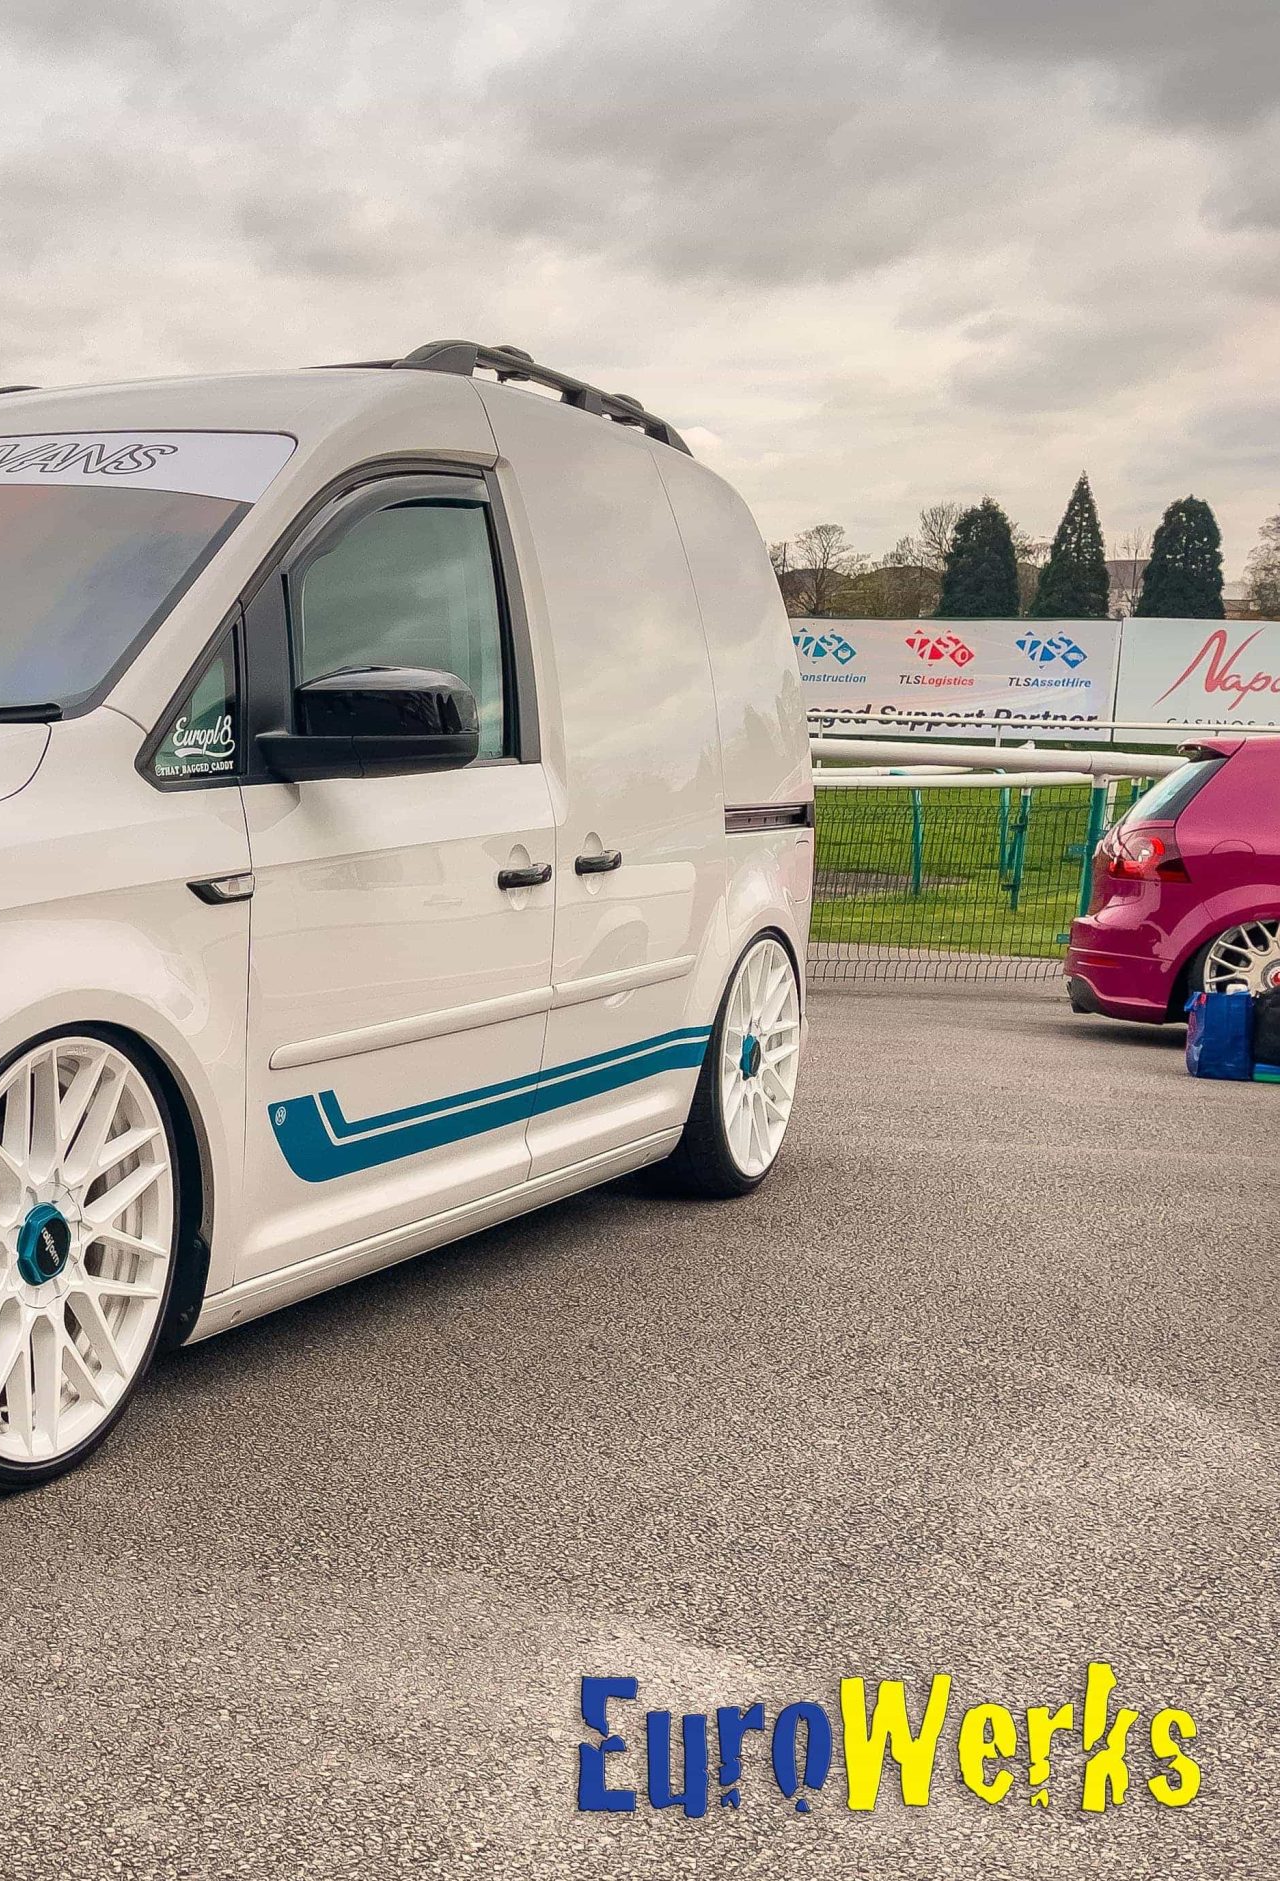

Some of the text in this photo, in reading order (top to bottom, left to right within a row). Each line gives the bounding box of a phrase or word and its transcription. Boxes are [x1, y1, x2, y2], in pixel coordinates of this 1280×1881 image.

[800, 672, 866, 684] onstruction
[899, 675, 975, 687] TLSLogistics
[1008, 677, 1091, 688] TLSAssetHire
[172, 714, 234, 757] Europl8
[41, 1226, 60, 1267] rotiform
